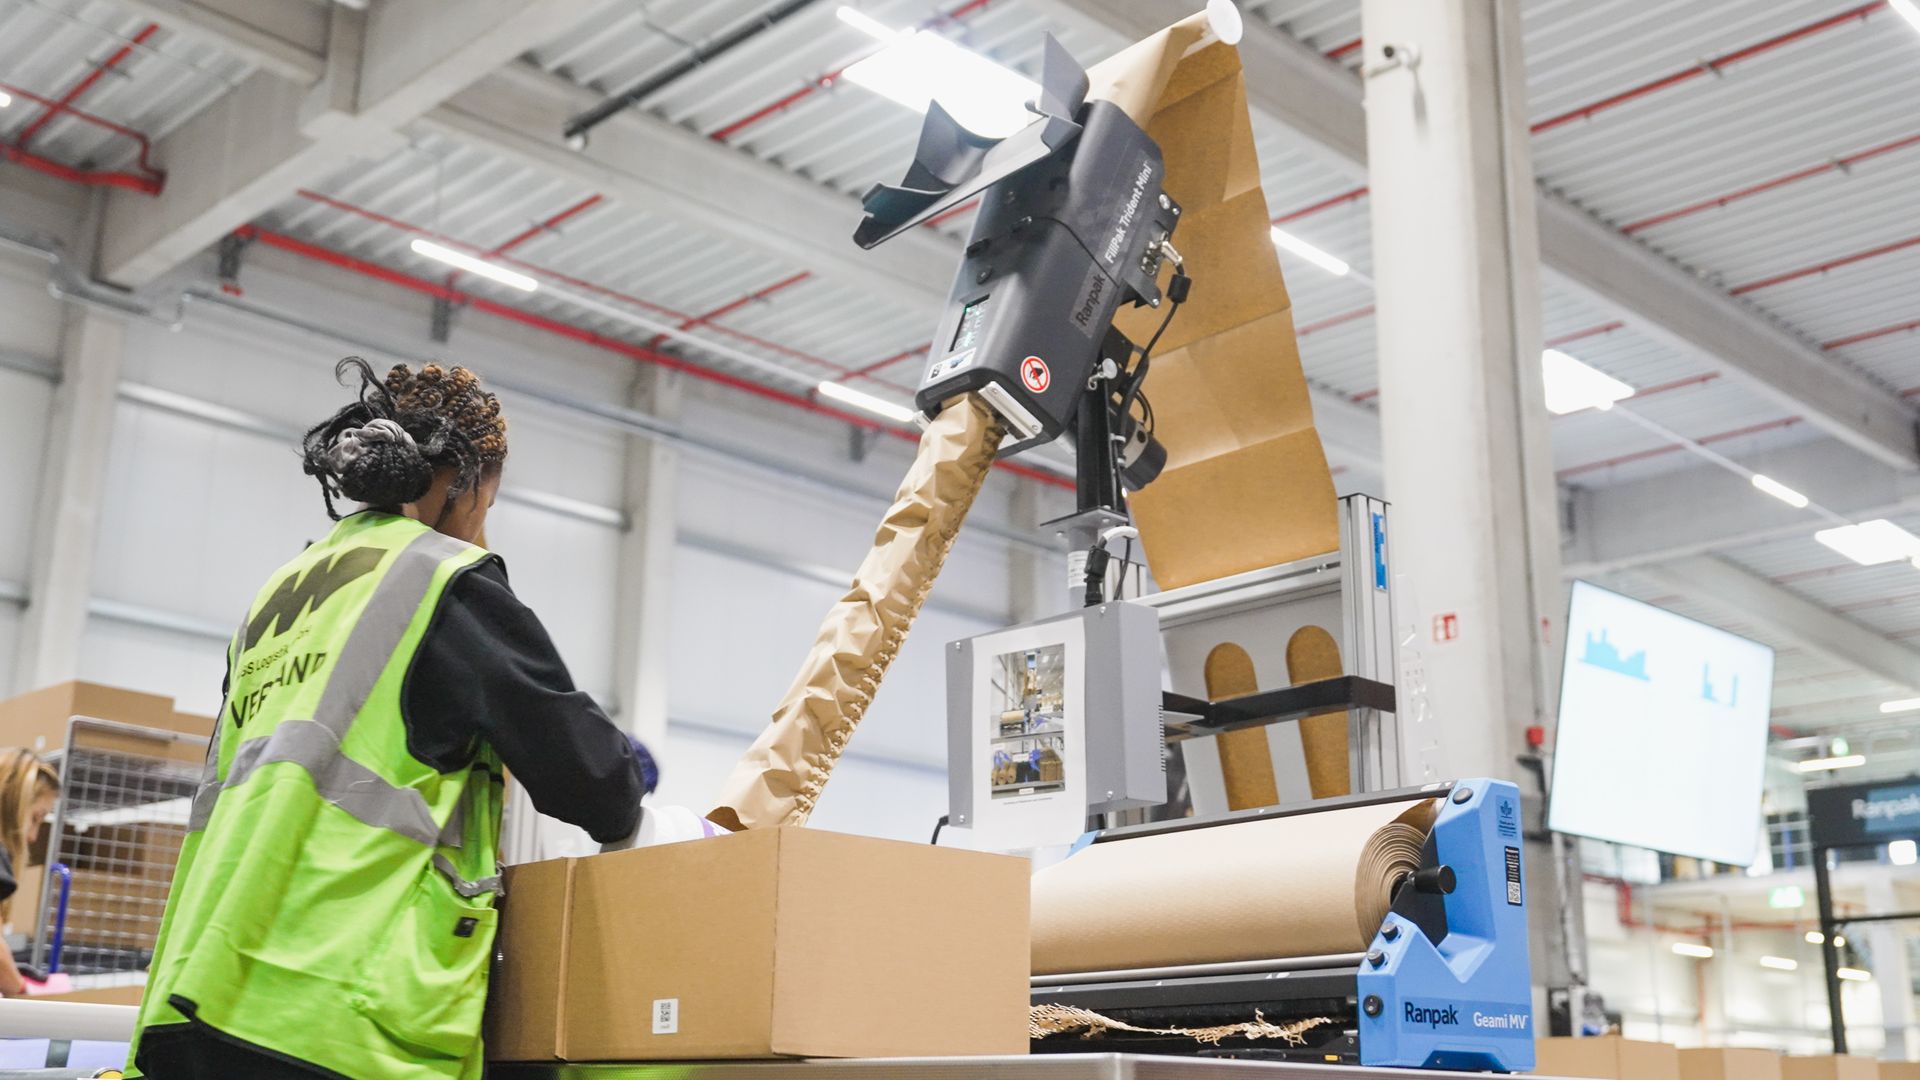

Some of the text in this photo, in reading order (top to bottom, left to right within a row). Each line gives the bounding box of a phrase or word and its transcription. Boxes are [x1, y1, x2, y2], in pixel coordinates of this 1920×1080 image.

[1104, 161, 1153, 264] FillPak Trident Mini
[1075, 275, 1105, 327] Ranpak
[1404, 1001, 1459, 1029] Ranpak
[1473, 1012, 1508, 1029] Geami
